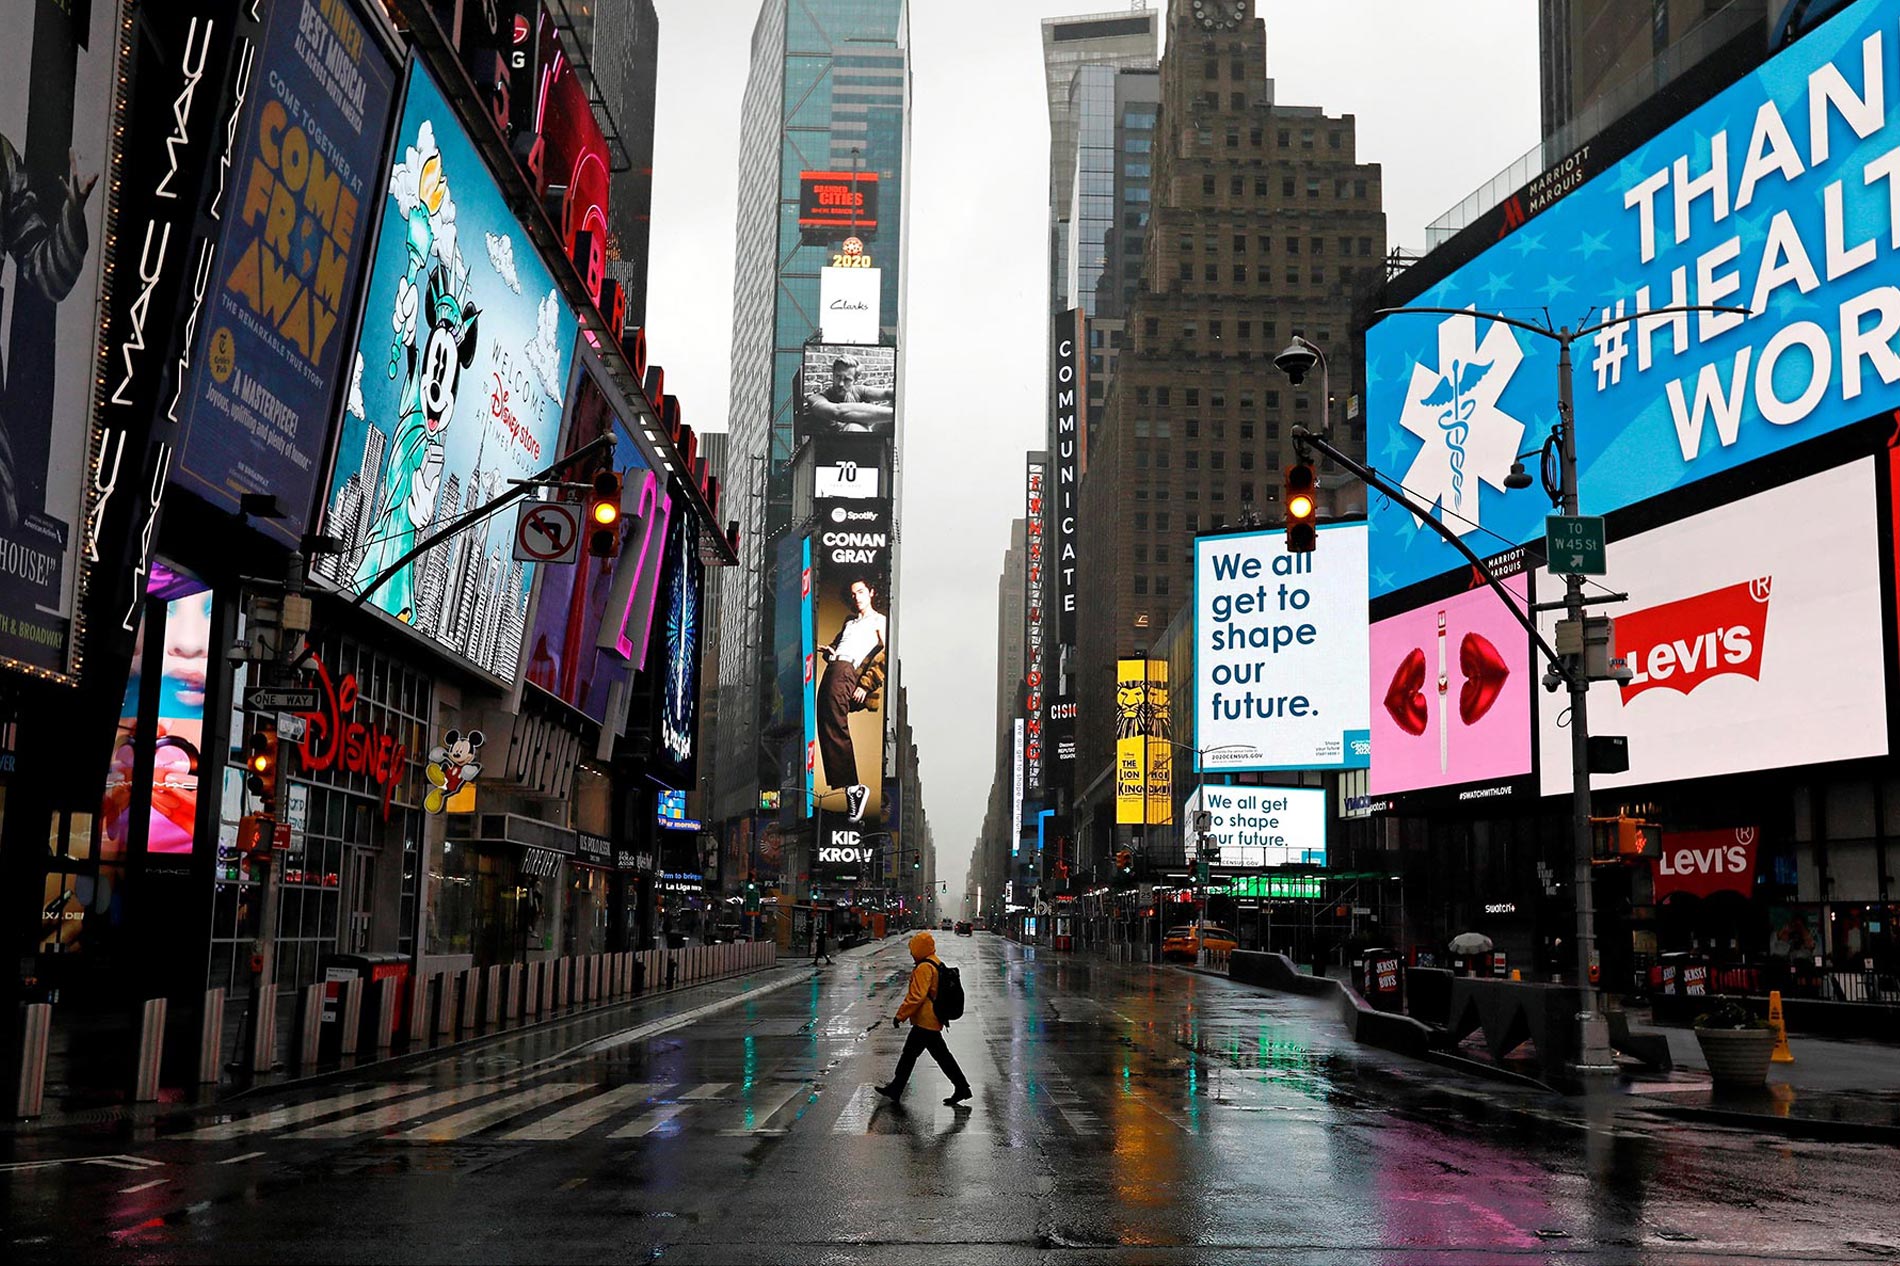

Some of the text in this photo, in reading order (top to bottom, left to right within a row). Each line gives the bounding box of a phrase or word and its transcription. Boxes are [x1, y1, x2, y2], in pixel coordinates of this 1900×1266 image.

[299, 0, 366, 116] BEST MUSICAL
[269, 70, 363, 193] COME TOGETHER AT
[1624, 28, 1900, 264] THAN
[260, 100, 358, 254] COME
[1529, 145, 1591, 196] MARRIOTT
[819, 191, 864, 206] CITIES
[1529, 168, 1583, 214] MARQUIS
[242, 156, 348, 311] FROM
[832, 254, 871, 268] 2020
[226, 237, 338, 367] AWAY
[830, 299, 869, 311] Clarks
[222, 292, 324, 390] THE REMARKABLE TRUE STORY
[491, 337, 546, 422] WELCOME
[205, 382, 230, 418] Joyous,
[256, 421, 270, 441] and
[267, 429, 287, 457] plenty
[285, 441, 293, 459] of
[491, 372, 541, 461] Disney store
[488, 420, 509, 453] TIMES
[835, 461, 857, 482] 70
[1058, 340, 1076, 613] COMMUNICATE
[847, 510, 879, 522] Spotify
[1568, 523, 1583, 534] TO
[822, 531, 886, 548] CONAN
[1554, 537, 1597, 550] W 45 St
[831, 550, 877, 563] GRAY
[1212, 551, 1312, 581] We all
[1488, 547, 1526, 568] MARRIOTT
[1211, 583, 1310, 623] get to
[10, 618, 17, 636] &
[18, 621, 64, 649] BROADWAY
[1211, 622, 1317, 654] shape
[1211, 662, 1266, 685] our
[255, 694, 309, 705] ONE WAY
[1211, 691, 1319, 721] future.
[293, 650, 409, 824] Disney
[1016, 724, 1024, 736] We
[1015, 749, 1023, 762] get
[1212, 752, 1263, 760] 2020CENSUS.GOV
[1119, 768, 1140, 781] LION
[1014, 773, 1022, 797] shape
[1118, 781, 1144, 796] KING
[1459, 786, 1513, 801] #SWATCHWITHLOVE
[1207, 794, 1288, 814] We all get
[1343, 795, 1371, 811] VIACO
[1229, 815, 1280, 831] shape
[831, 830, 861, 845] KID
[1238, 832, 1289, 847] future.
[818, 847, 873, 863] KROW
[1376, 959, 1398, 974] JERSEY
[1683, 966, 1707, 982] JERSEY
[1378, 974, 1397, 988] BOYS
